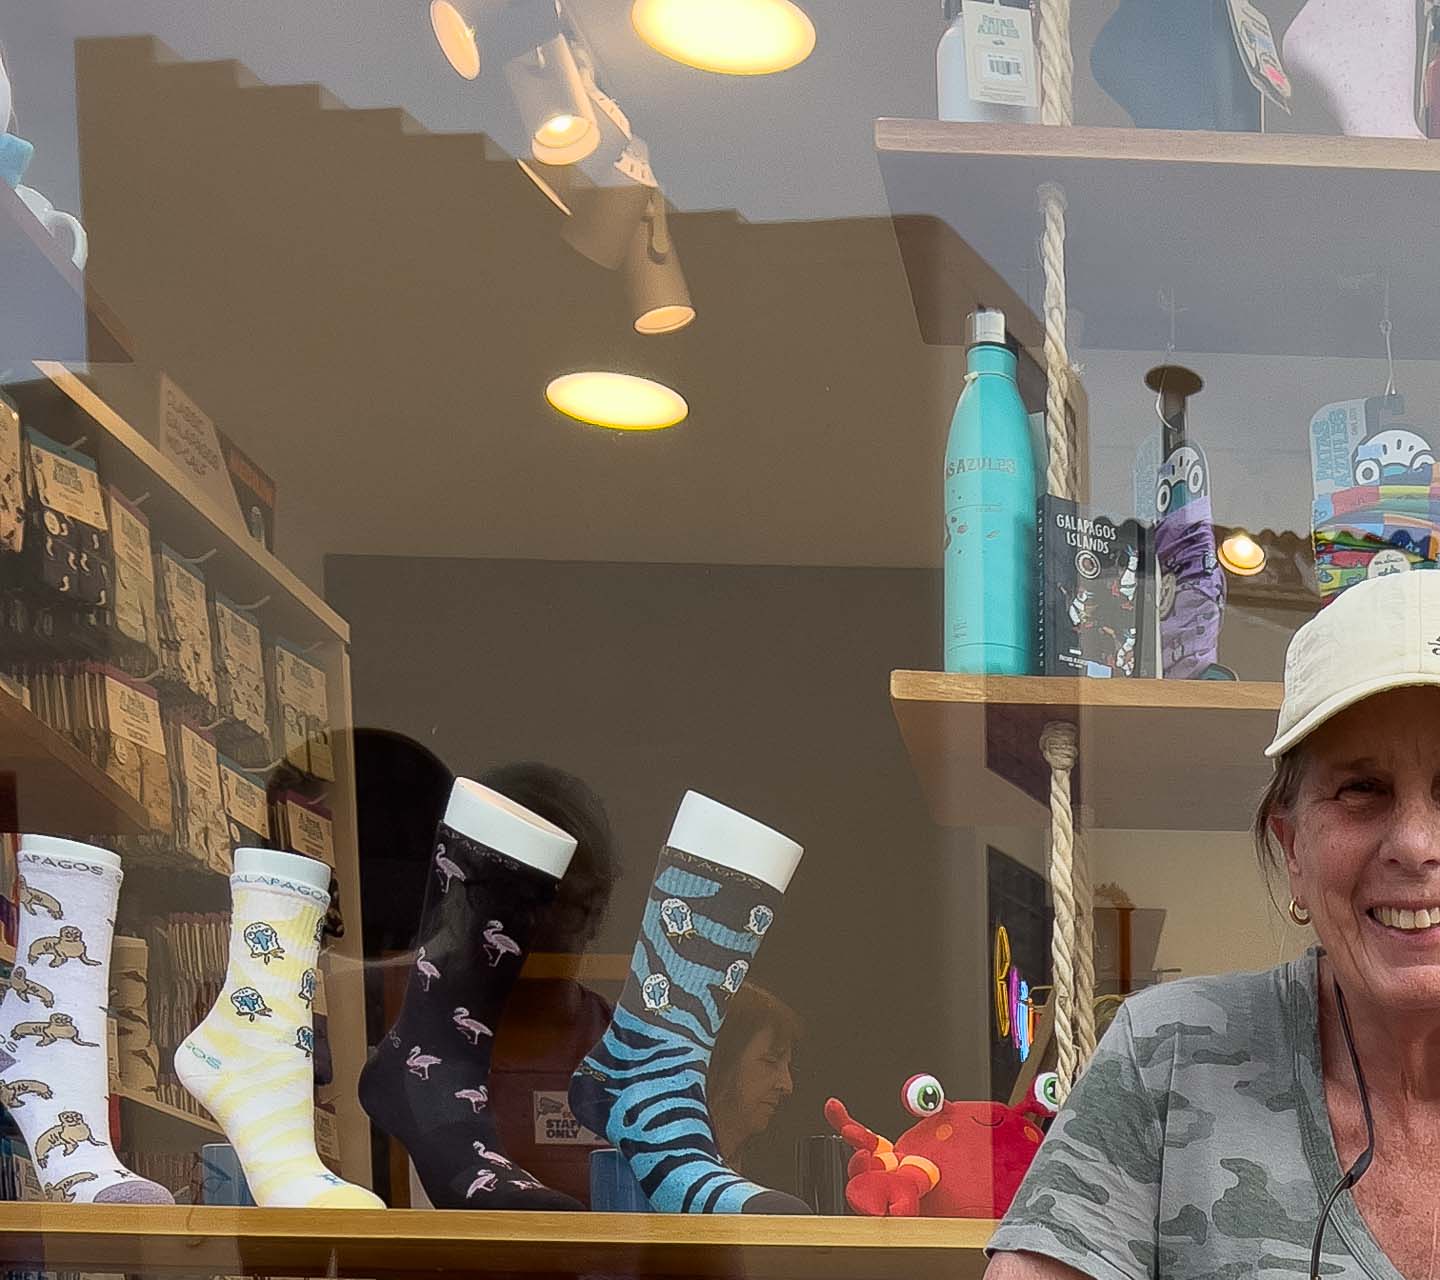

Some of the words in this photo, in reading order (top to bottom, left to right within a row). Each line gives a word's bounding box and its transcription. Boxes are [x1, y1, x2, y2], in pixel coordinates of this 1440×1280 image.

[1056, 513, 1117, 541] GALAPAGOS
[1066, 532, 1109, 554] ISLANDS
[546, 1129, 579, 1139] ONLY
